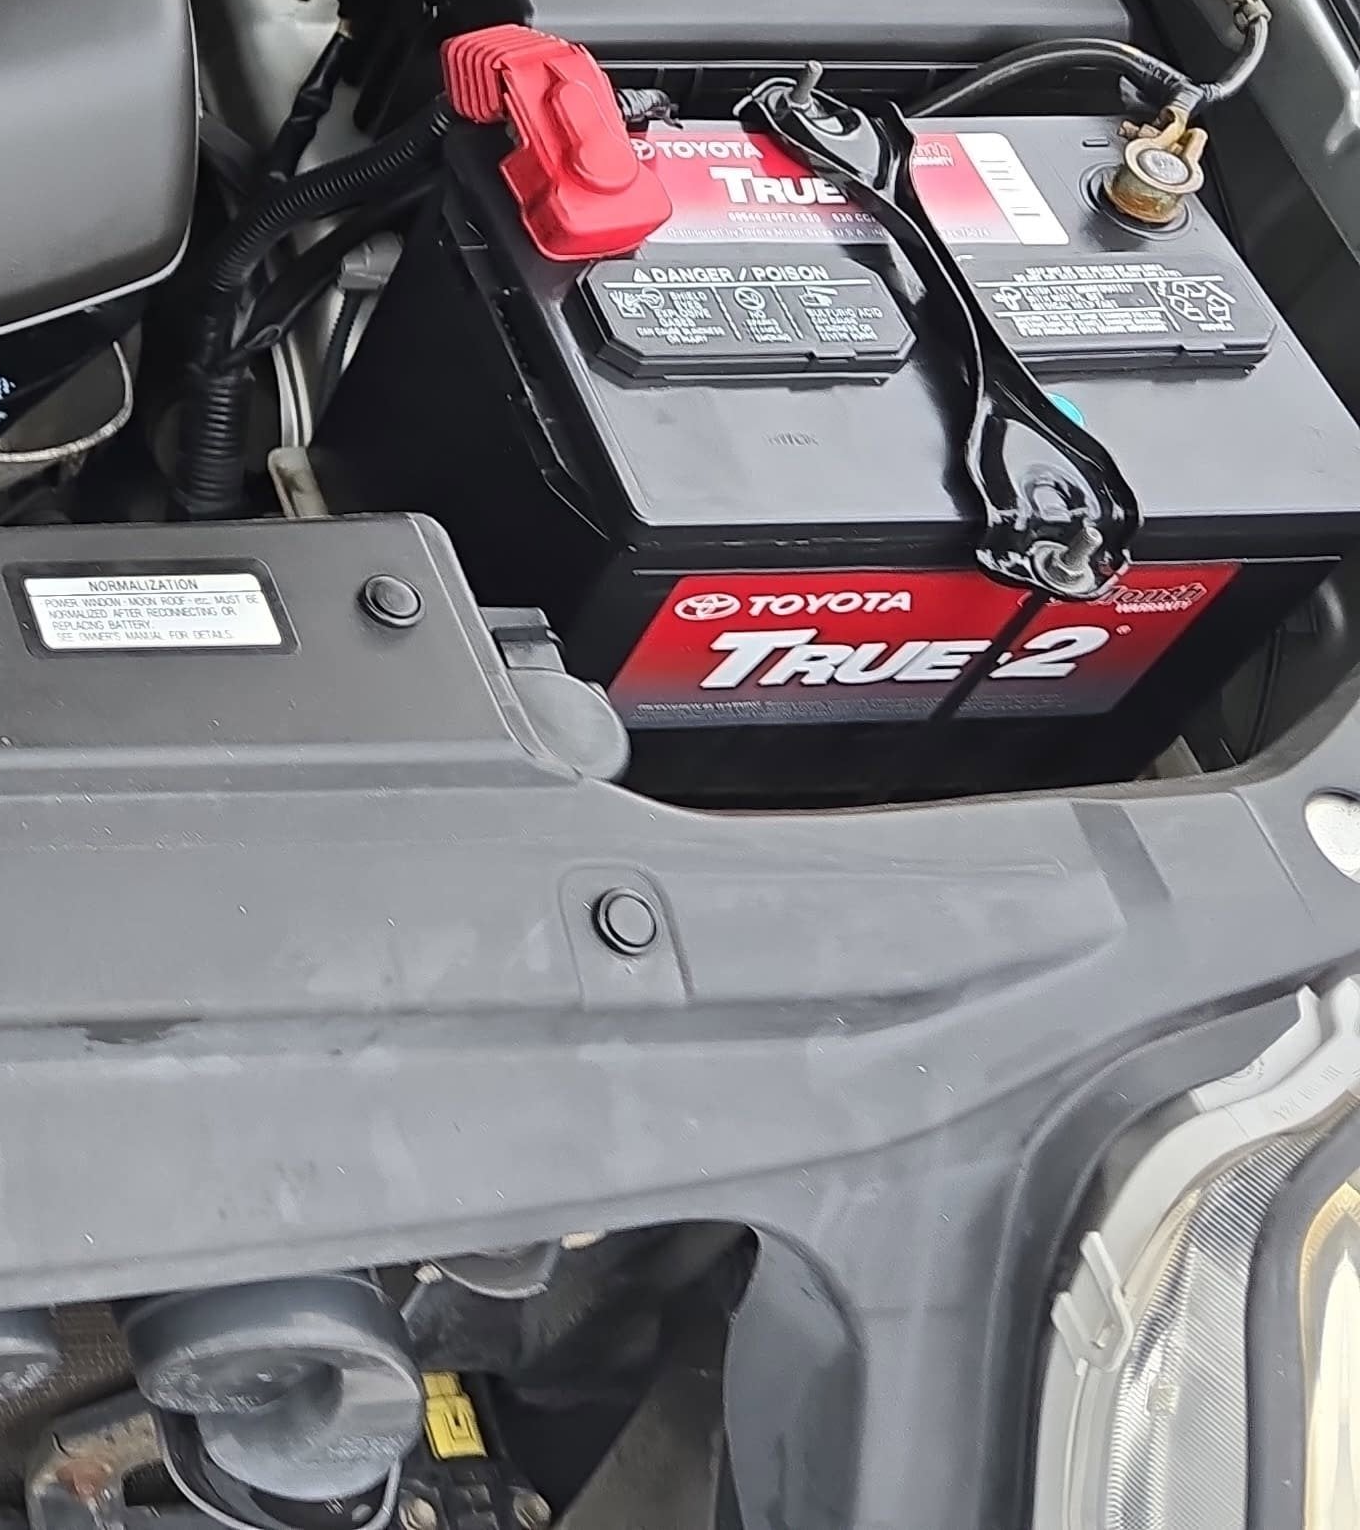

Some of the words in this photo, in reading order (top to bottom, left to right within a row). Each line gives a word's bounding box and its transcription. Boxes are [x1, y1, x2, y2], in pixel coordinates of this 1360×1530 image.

[654, 141, 764, 160] TOYOTA
[709, 166, 849, 206] TRUE
[649, 266, 737, 283] DANGER
[738, 266, 748, 282] /
[750, 264, 831, 281] POISON
[857, 307, 884, 318] ACID
[88, 578, 199, 592] NORMALIZATION
[44, 598, 79, 608] POWER
[214, 594, 240, 605] MUST
[245, 594, 260, 604] BE
[748, 591, 912, 617] TOYOTA
[48, 609, 108, 619] NORMALIZED
[113, 608, 144, 618] AFTER
[146, 607, 217, 617] RECONNECTING
[221, 606, 238, 616] OR
[52, 620, 105, 631] REPLACING
[124, 631, 165, 641] MANUAL
[168, 630, 189, 640] FOR
